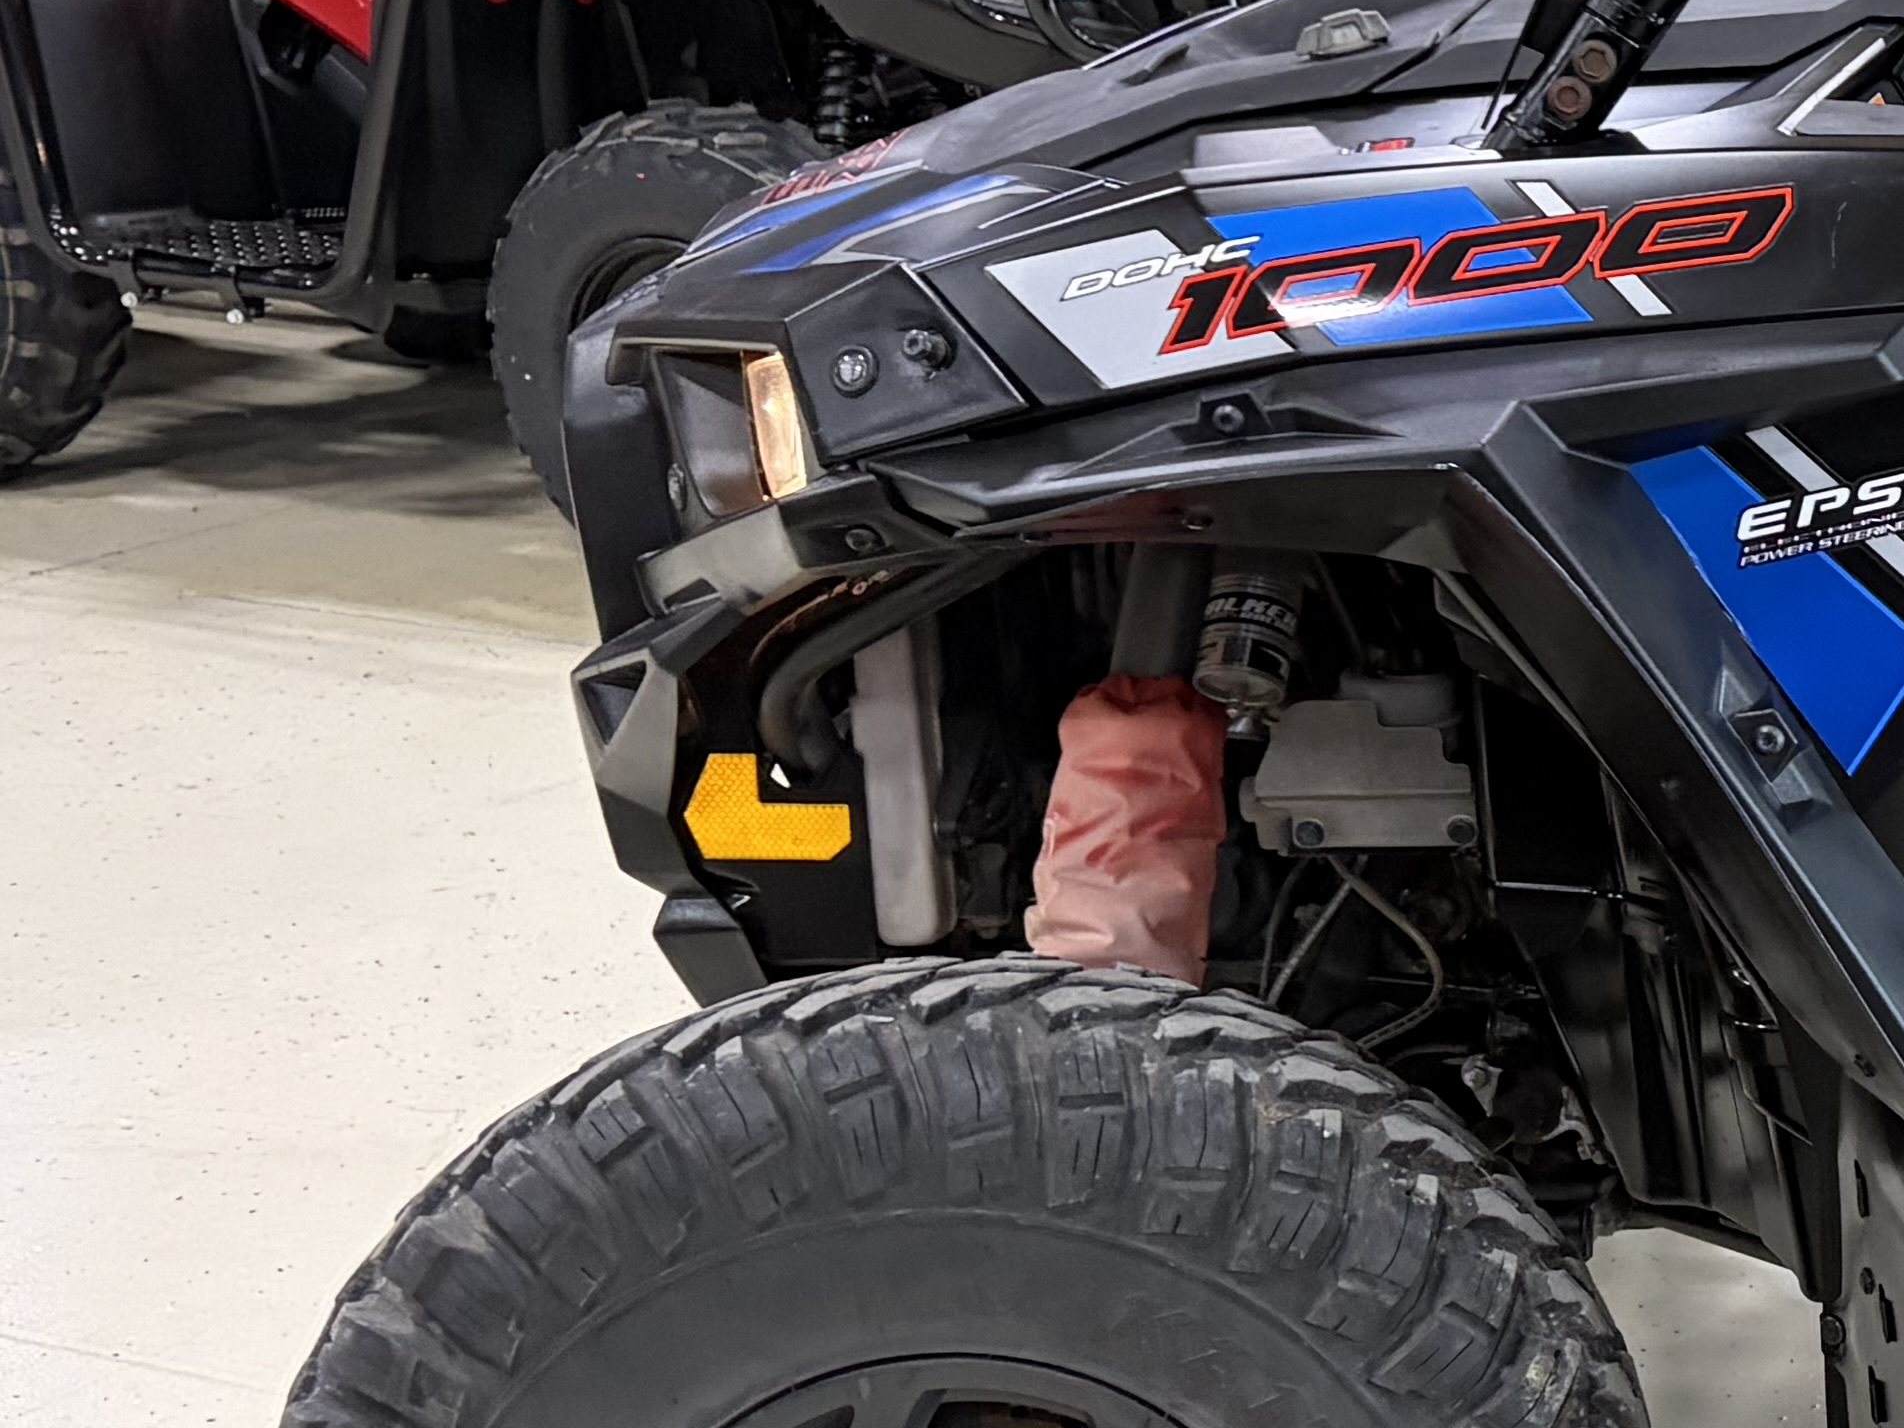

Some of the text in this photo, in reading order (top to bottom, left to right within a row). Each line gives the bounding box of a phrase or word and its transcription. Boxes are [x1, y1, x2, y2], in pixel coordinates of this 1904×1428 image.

[1060, 235, 1261, 302] DOHC
[1158, 185, 1794, 355] 1000
[1740, 540, 1814, 568] POWER
